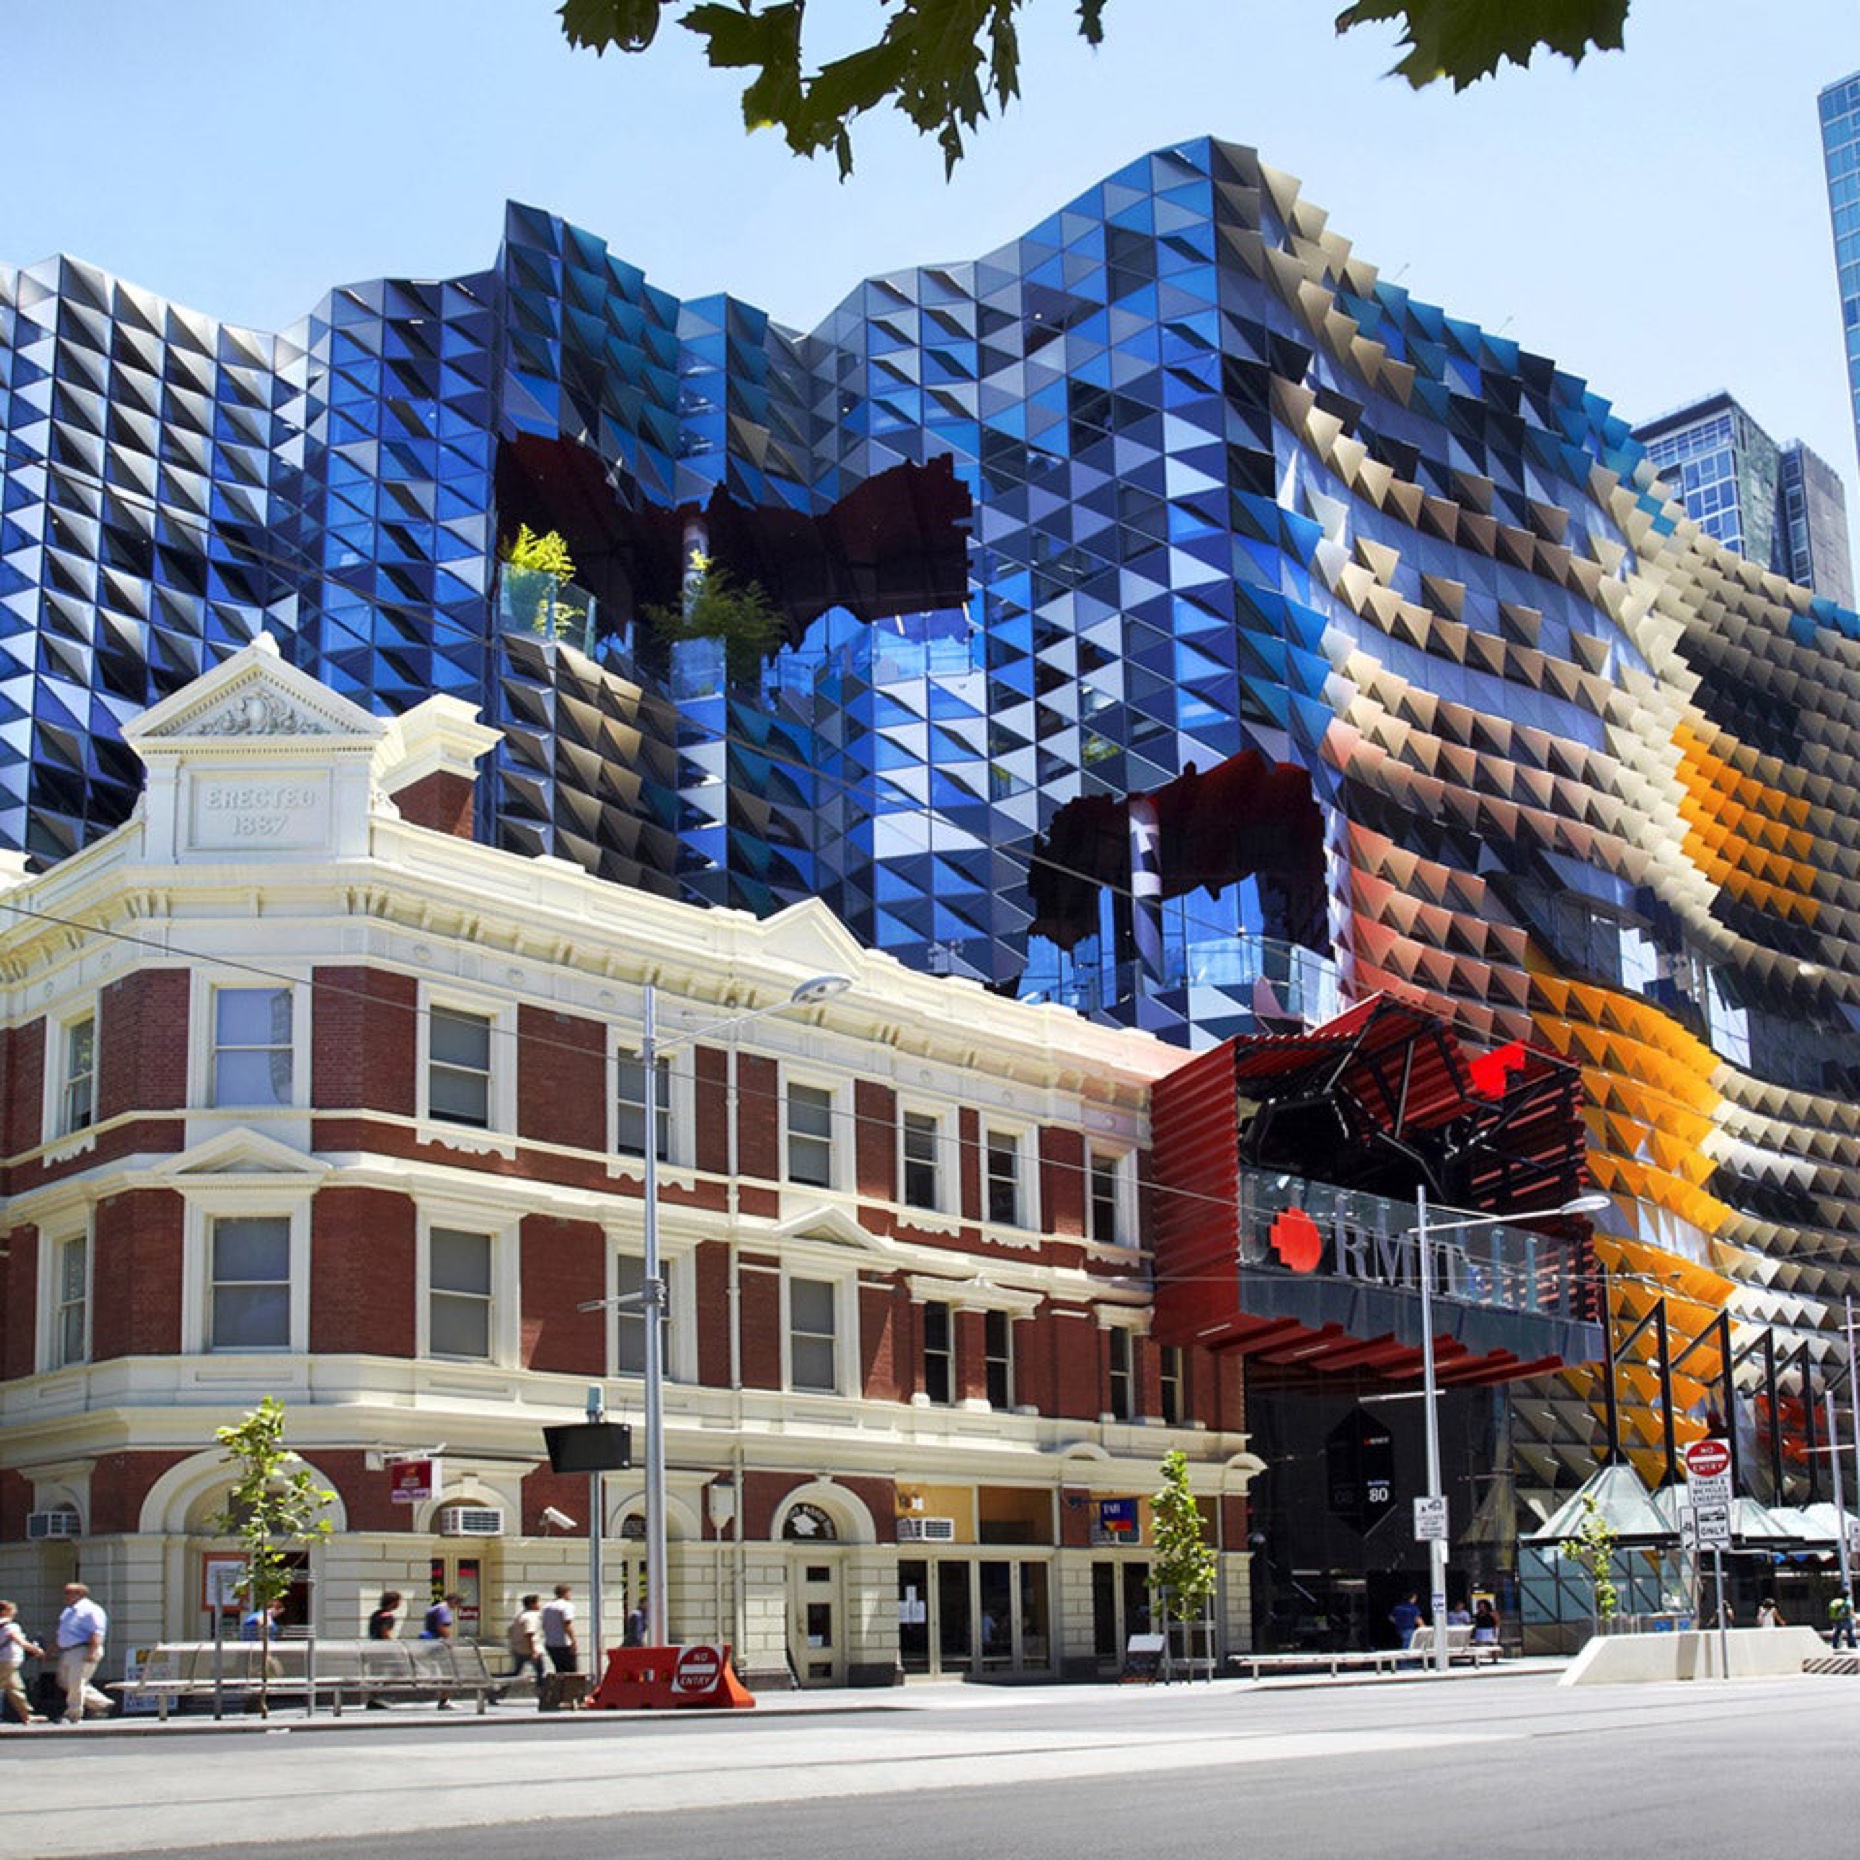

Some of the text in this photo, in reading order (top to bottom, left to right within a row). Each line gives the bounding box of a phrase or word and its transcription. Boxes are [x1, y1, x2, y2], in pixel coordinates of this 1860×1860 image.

[205, 786, 316, 809] ERECTED
[231, 815, 290, 836] 1887
[1332, 1220, 1471, 1299] RMIT
[1700, 1446, 1714, 1454] NO
[1693, 1462, 1724, 1472] ENTRY
[1369, 1487, 1389, 1502] 80
[1701, 1526, 1725, 1536] ONLY
[693, 1652, 708, 1661] NO
[681, 1675, 710, 1685] ENTRY
